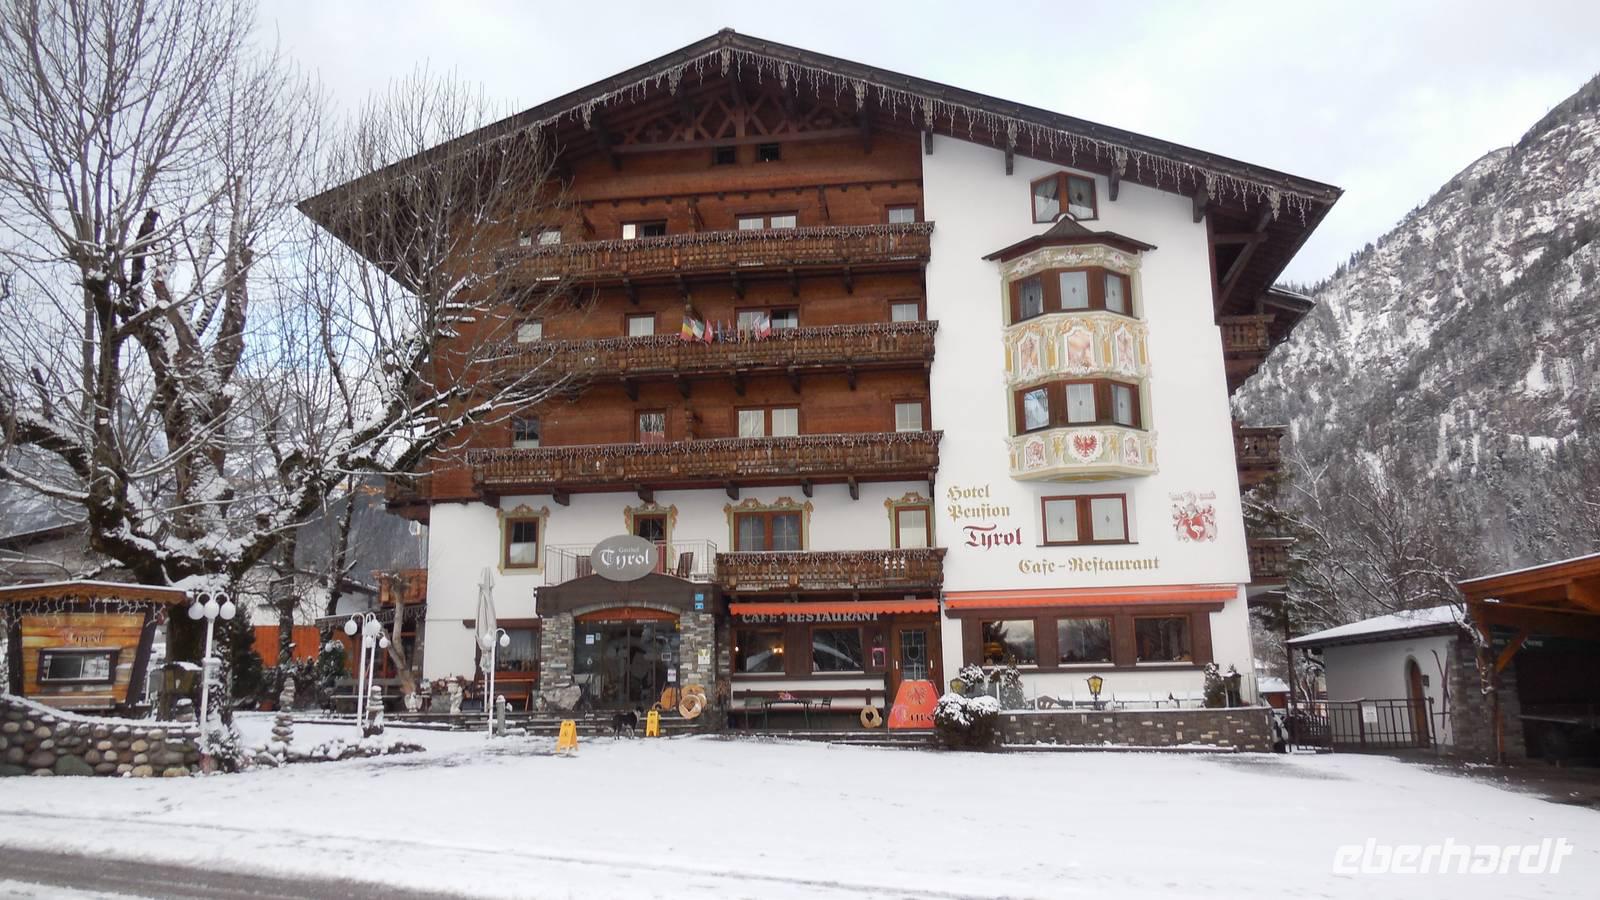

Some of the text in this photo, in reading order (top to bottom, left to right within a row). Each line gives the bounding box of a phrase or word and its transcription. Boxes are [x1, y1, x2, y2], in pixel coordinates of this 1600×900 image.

[947, 484, 990, 501] Hotel
[963, 523, 1022, 550] Tyrol
[600, 547, 650, 569] Tyrol
